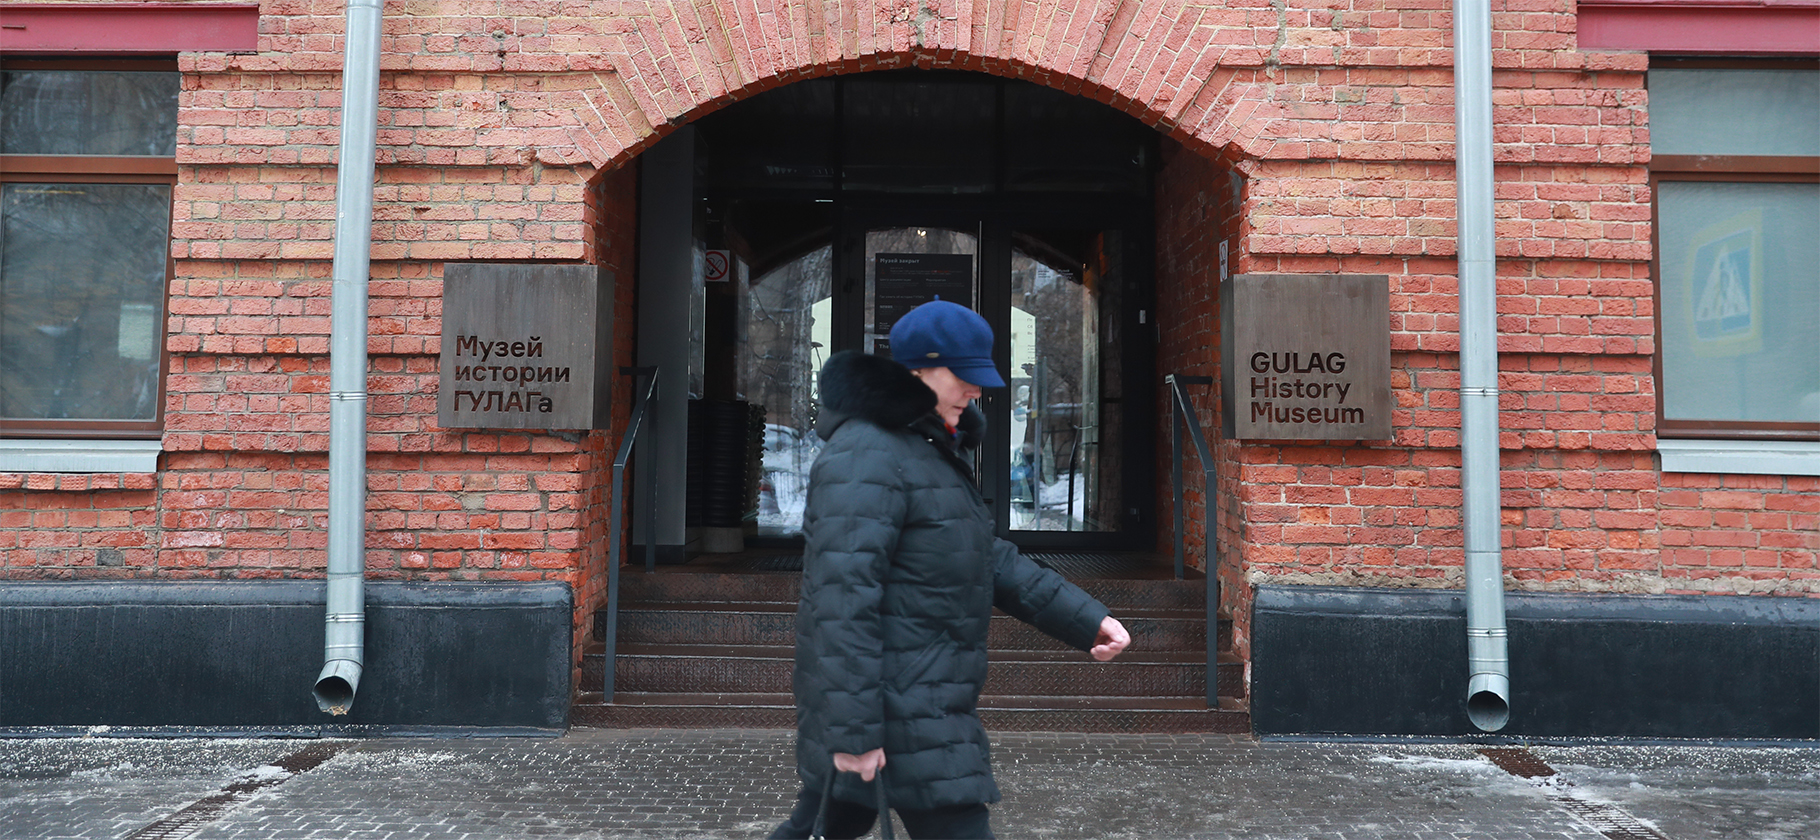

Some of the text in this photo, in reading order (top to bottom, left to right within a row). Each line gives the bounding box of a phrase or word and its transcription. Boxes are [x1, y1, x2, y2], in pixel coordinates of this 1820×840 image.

[456, 335, 543, 362] Музей
[1250, 351, 1346, 374] GULAG
[455, 365, 570, 388] истории
[453, 390, 553, 413] ГУЛАГа
[1250, 376, 1351, 404] History
[1251, 401, 1364, 423] Museum
